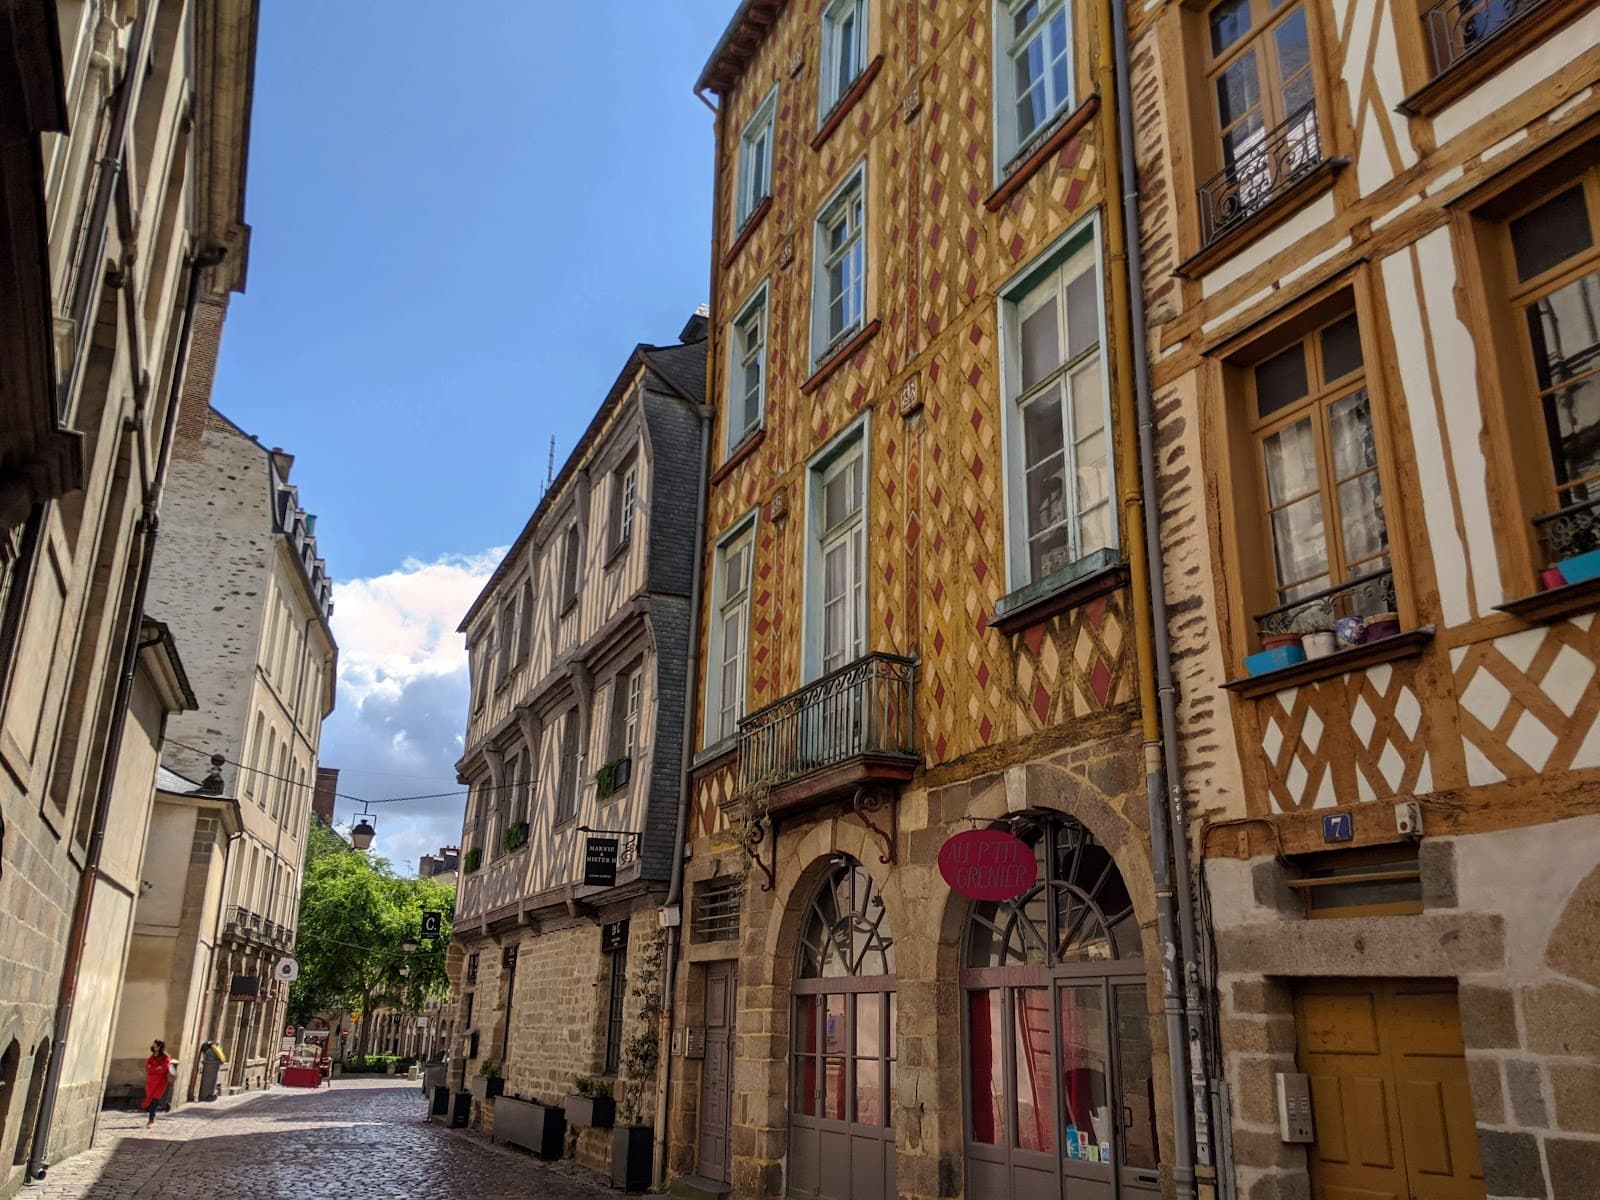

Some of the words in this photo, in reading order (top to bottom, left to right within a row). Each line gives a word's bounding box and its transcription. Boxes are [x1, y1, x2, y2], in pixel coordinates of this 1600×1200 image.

[1331, 817, 1342, 838] 7
[946, 841, 970, 865] AU
[956, 865, 1028, 889] GRENIER
